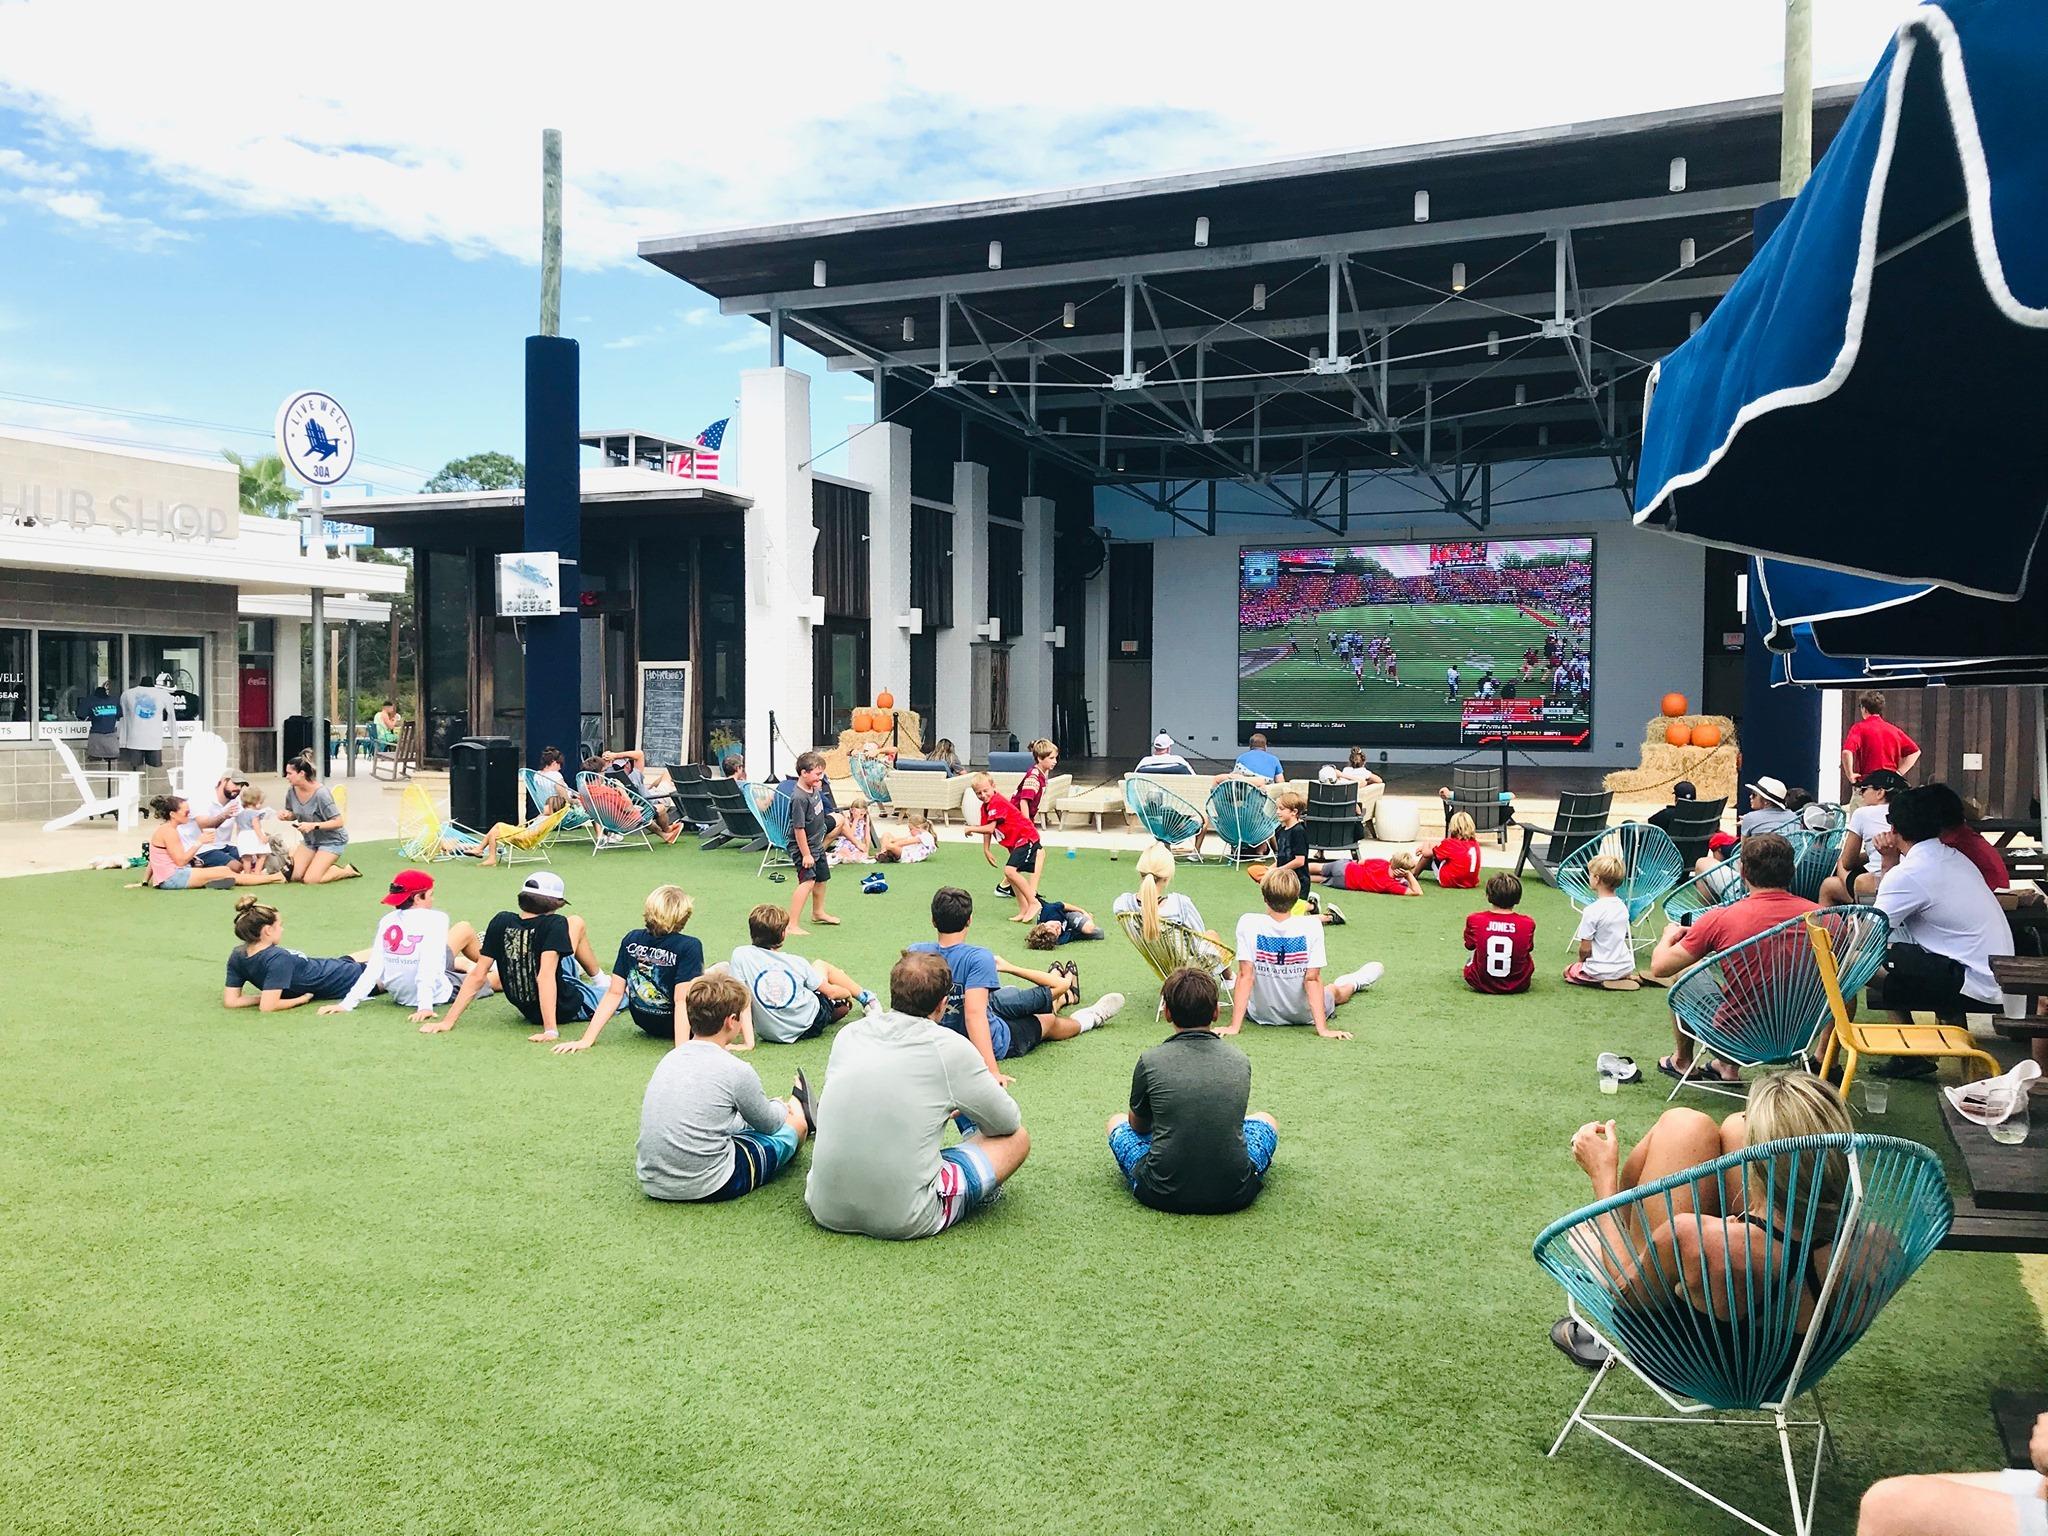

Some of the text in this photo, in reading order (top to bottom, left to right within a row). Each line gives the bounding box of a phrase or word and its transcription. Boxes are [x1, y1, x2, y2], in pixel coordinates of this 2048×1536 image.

[291, 399, 347, 432] LIVE WELL
[313, 465, 330, 478] 30A
[109, 493, 228, 542] SHOP
[71, 726, 88, 734] HUB
[1468, 846, 1477, 873] 1
[1486, 921, 1516, 933] JONES
[649, 946, 677, 966] TOWN
[1486, 935, 1513, 977] 8
